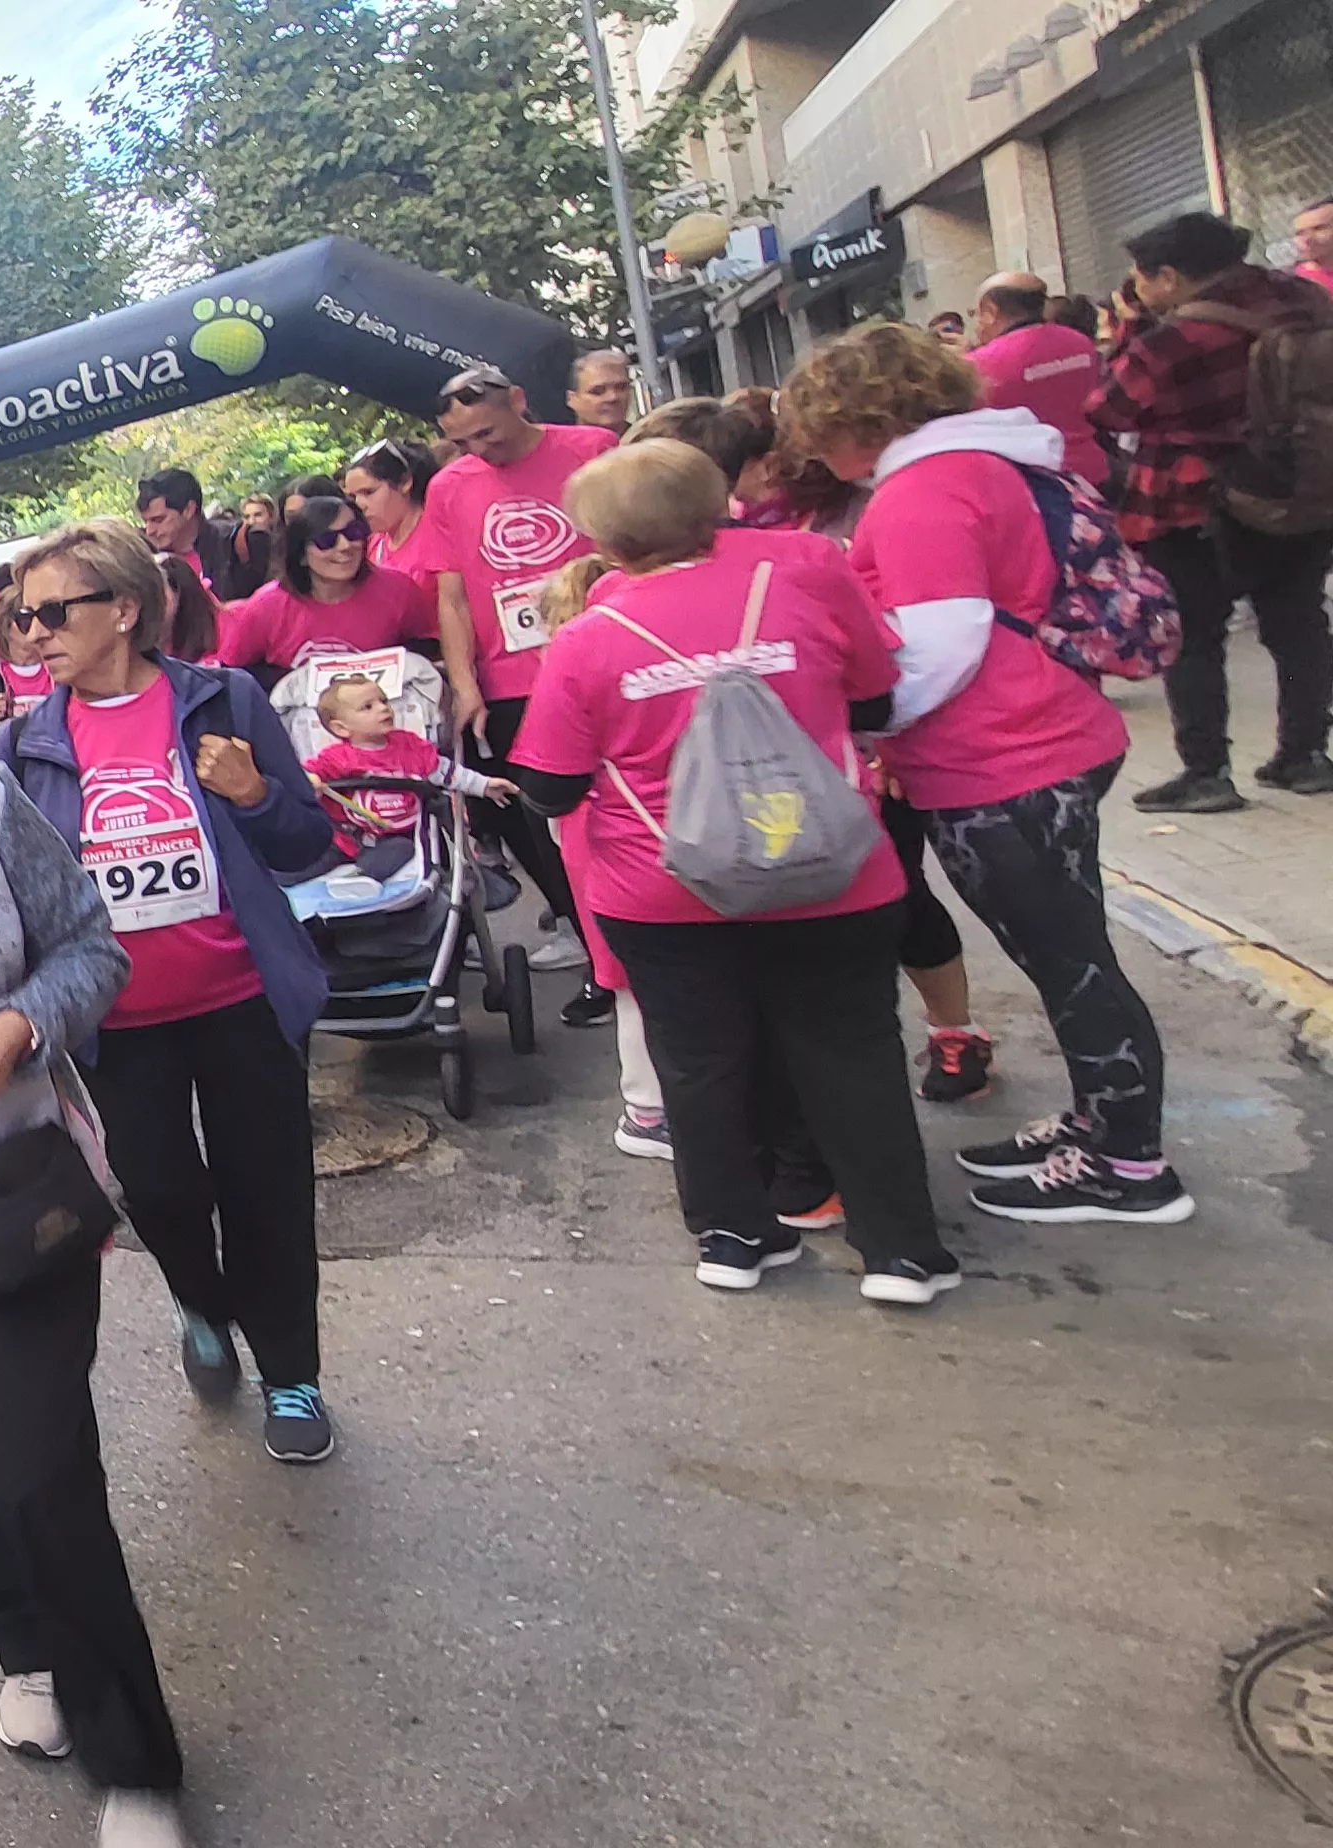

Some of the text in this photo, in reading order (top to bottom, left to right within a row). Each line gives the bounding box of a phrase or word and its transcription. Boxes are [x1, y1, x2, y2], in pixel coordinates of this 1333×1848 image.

[102, 813, 147, 832] JUNTOS
[80, 849, 125, 864] ONTRA
[125, 847, 141, 859] EL
